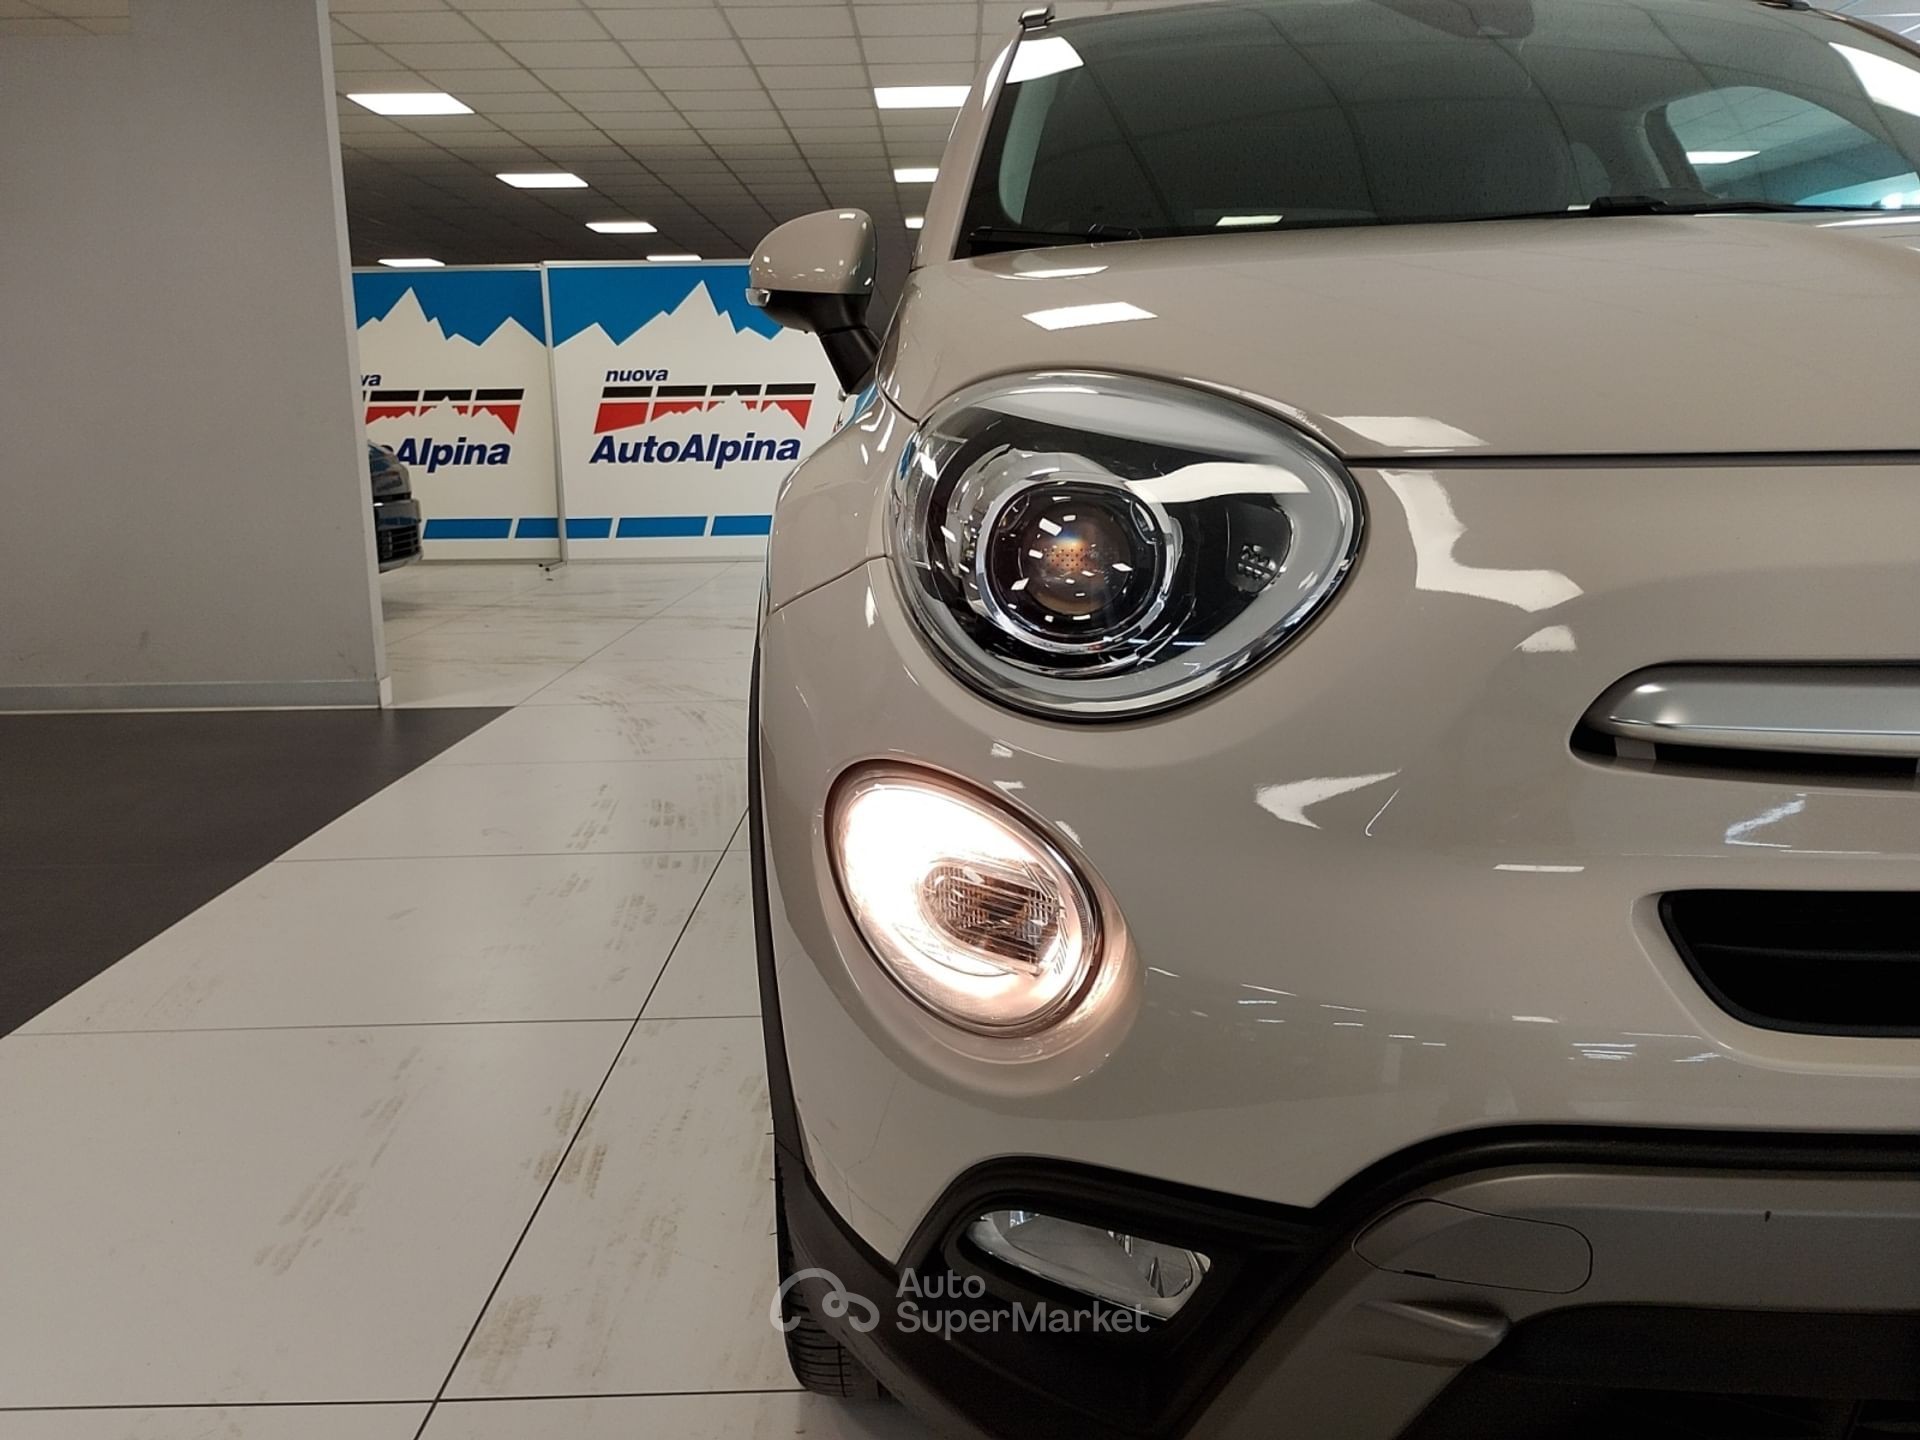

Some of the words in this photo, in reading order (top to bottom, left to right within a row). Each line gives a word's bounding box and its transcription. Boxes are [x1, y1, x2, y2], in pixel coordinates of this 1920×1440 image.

[605, 369, 668, 382] nuova
[381, 437, 511, 473] Alpina
[589, 432, 801, 469] AutoAlpina
